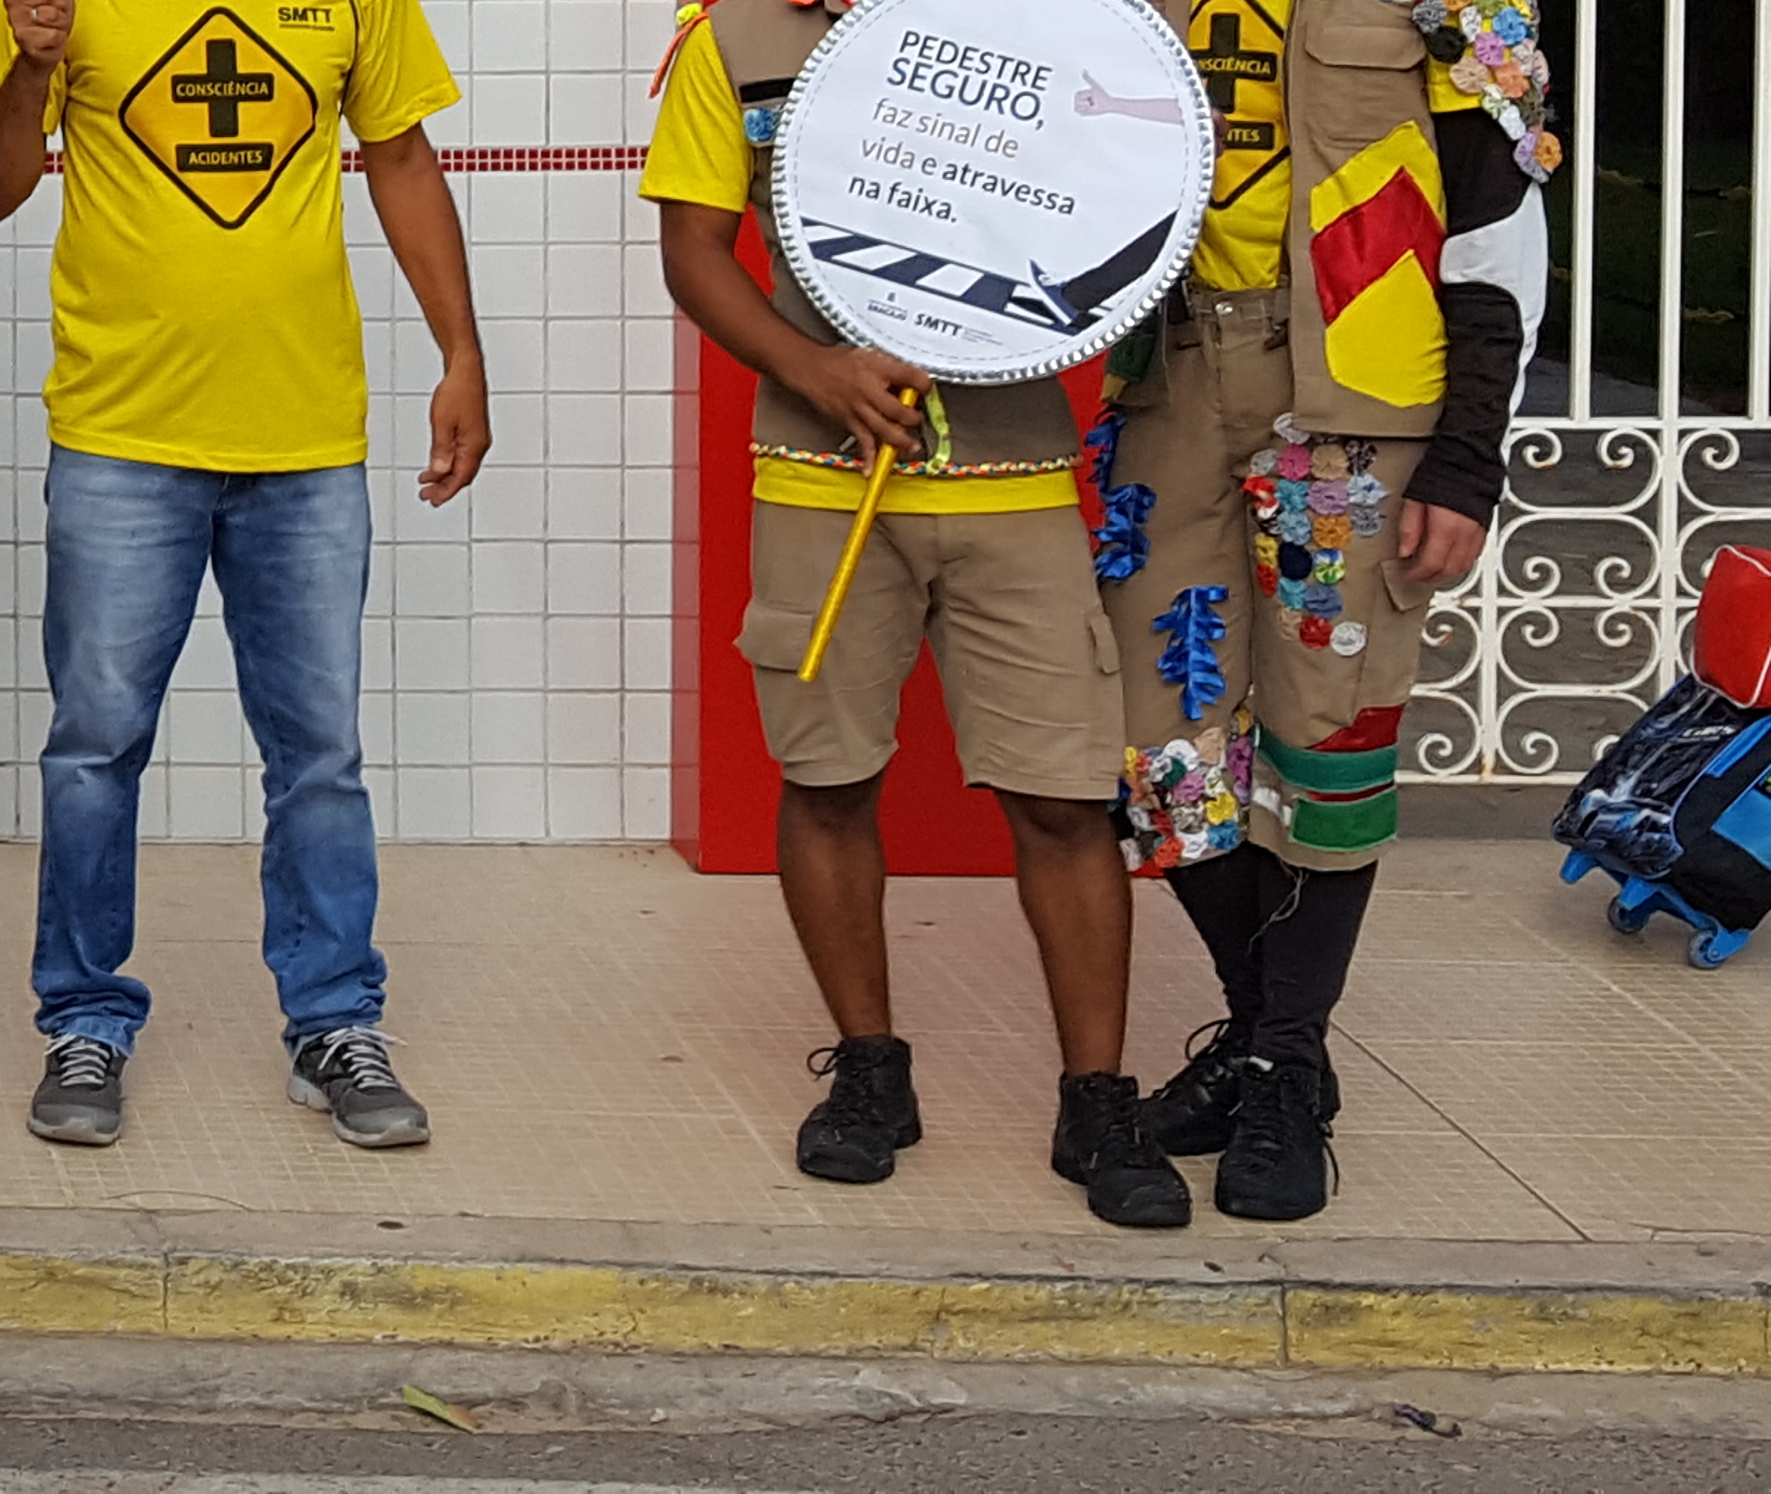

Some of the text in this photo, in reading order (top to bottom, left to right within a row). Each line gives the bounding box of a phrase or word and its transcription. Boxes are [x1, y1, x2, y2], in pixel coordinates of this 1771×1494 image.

[278, 7, 332, 23] SMTT
[898, 30, 1053, 92] PEDESTRE
[176, 81, 269, 96] CONSCIÊNCIA
[887, 57, 1045, 130] SEGURO,
[872, 99, 1019, 158] faz sinal de
[189, 151, 263, 164] ACIDENTES
[862, 138, 1076, 215] vida e atravessa
[848, 176, 957, 223] na faixa.
[914, 313, 963, 335] SMTT
